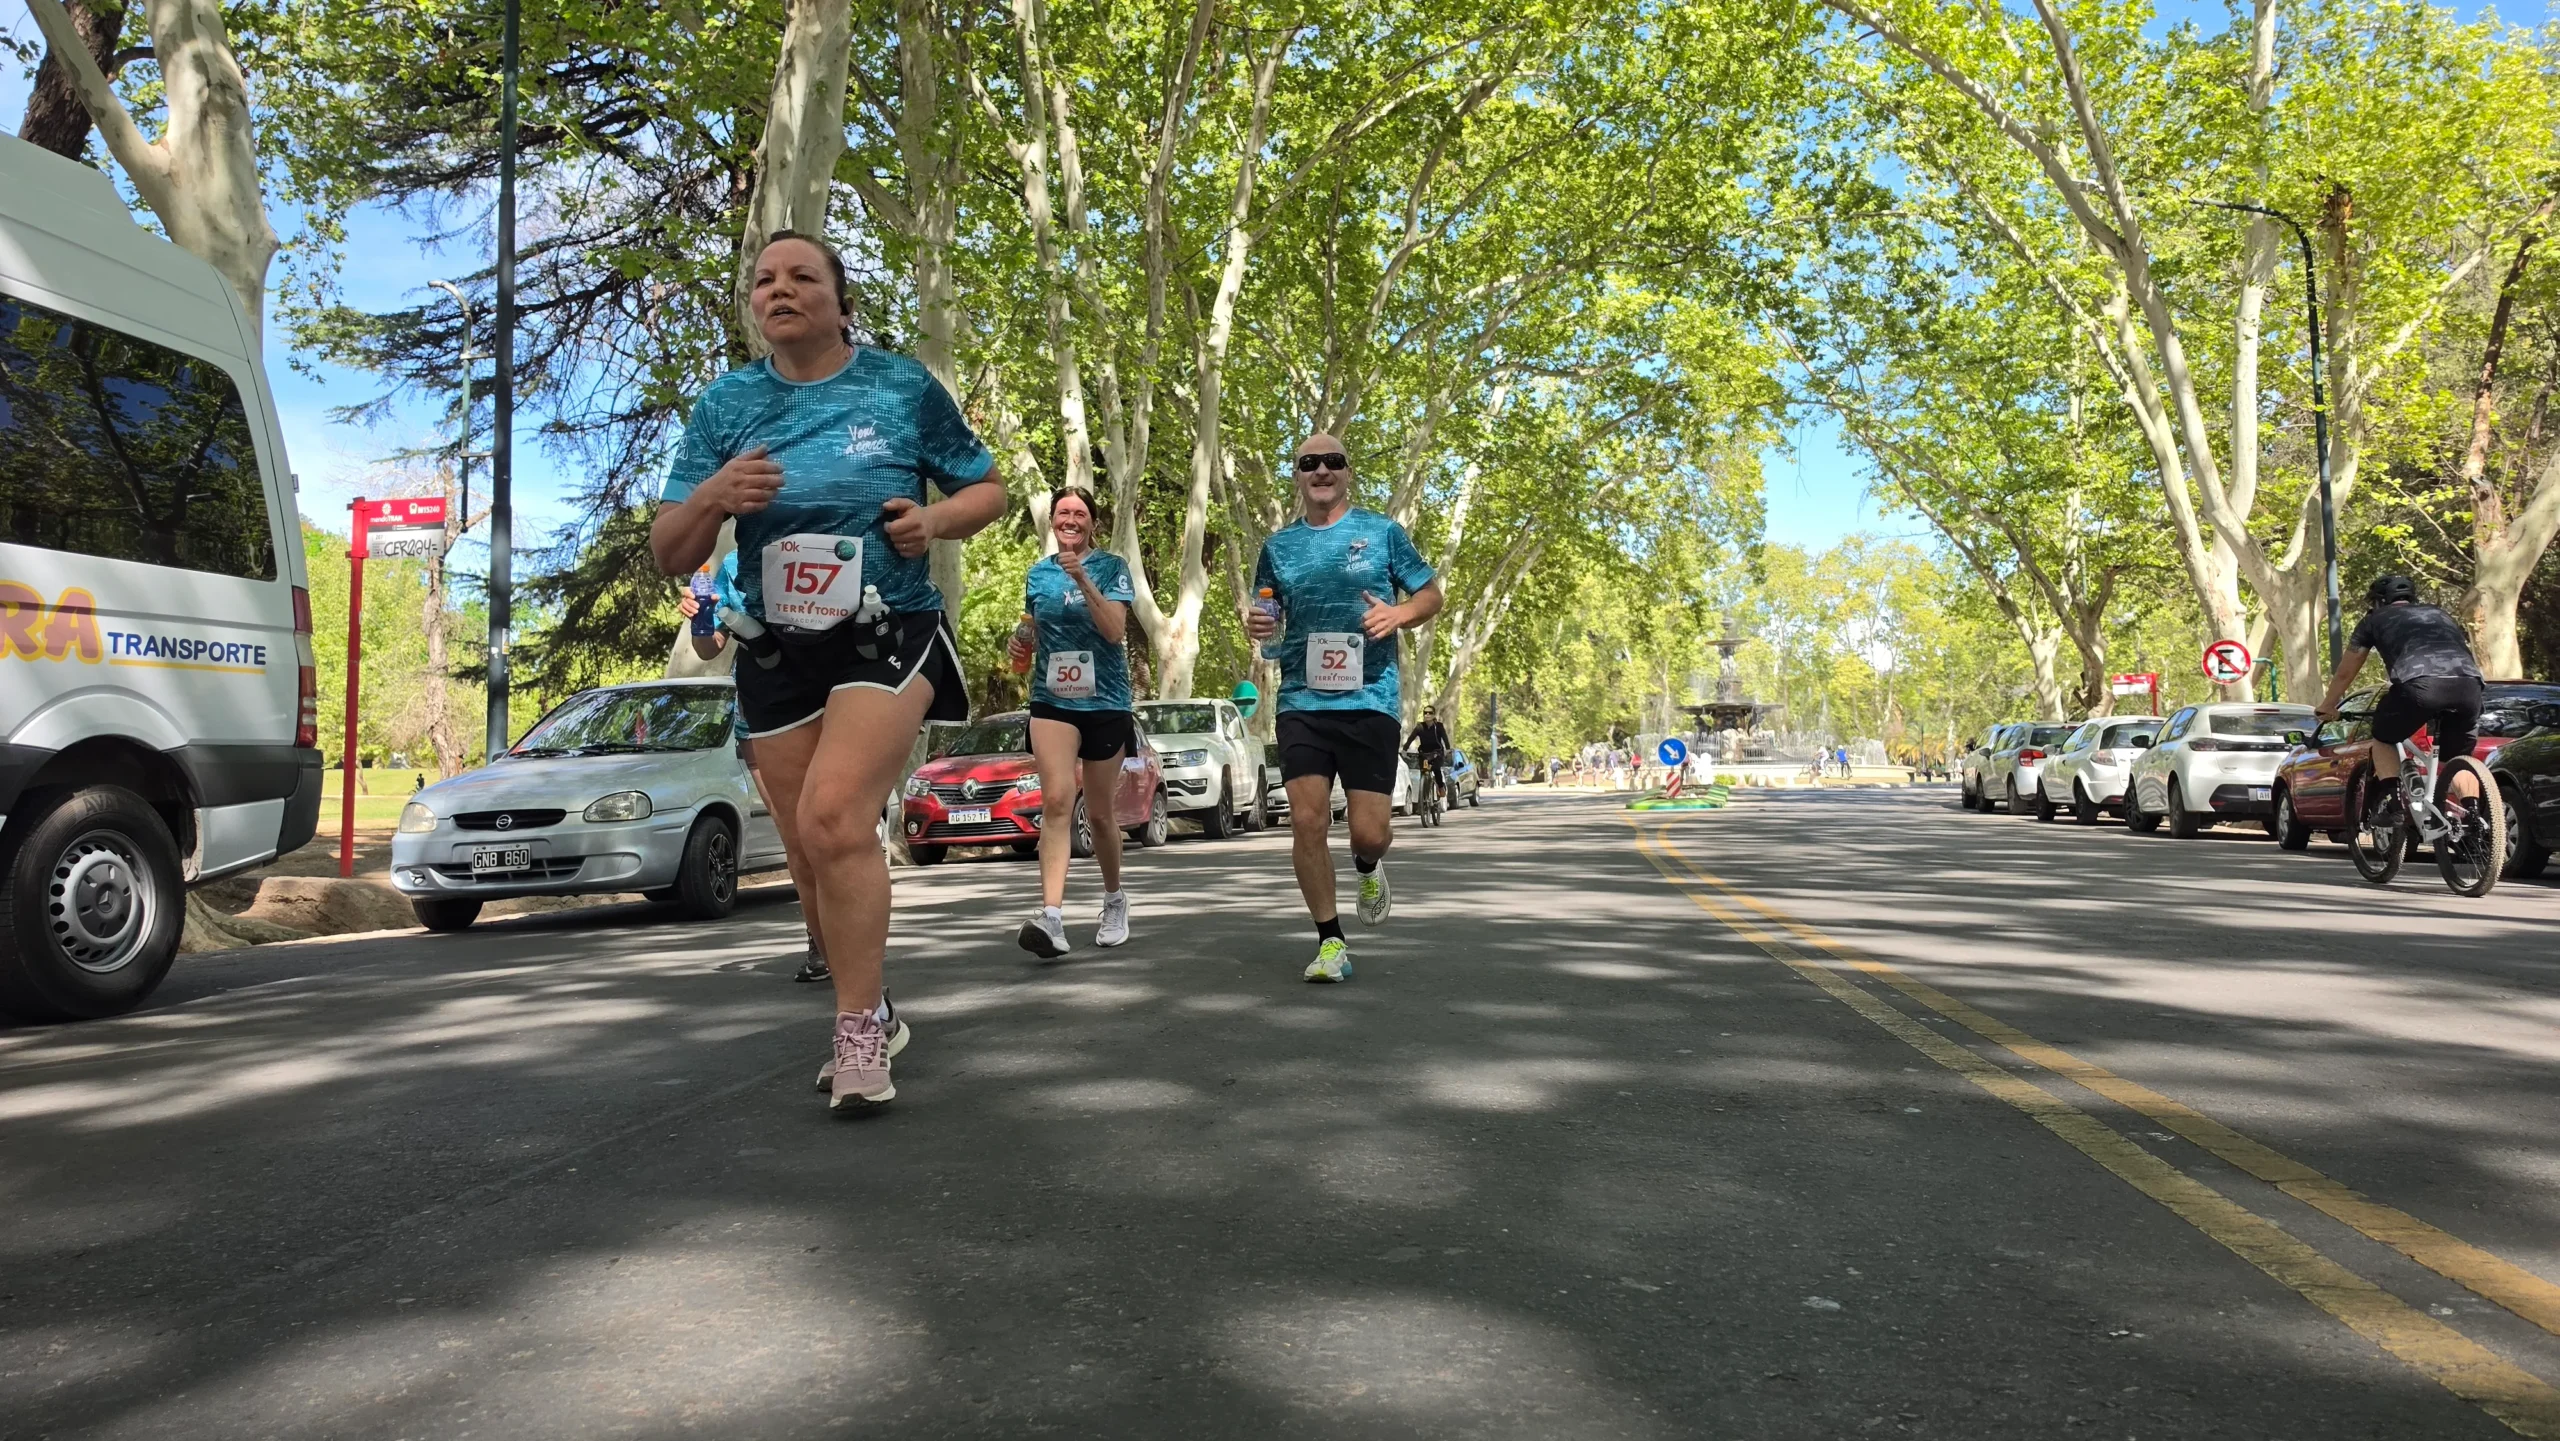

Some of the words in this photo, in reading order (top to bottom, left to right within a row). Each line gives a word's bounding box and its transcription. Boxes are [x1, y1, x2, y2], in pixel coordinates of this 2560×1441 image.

[780, 541, 800, 552] 10k
[783, 561, 843, 595] 157
[107, 631, 267, 666] TRANSPORTE
[1321, 649, 1348, 669] 52
[1056, 665, 1082, 683] 50
[474, 852, 497, 868] GNB
[505, 850, 527, 865] 860
